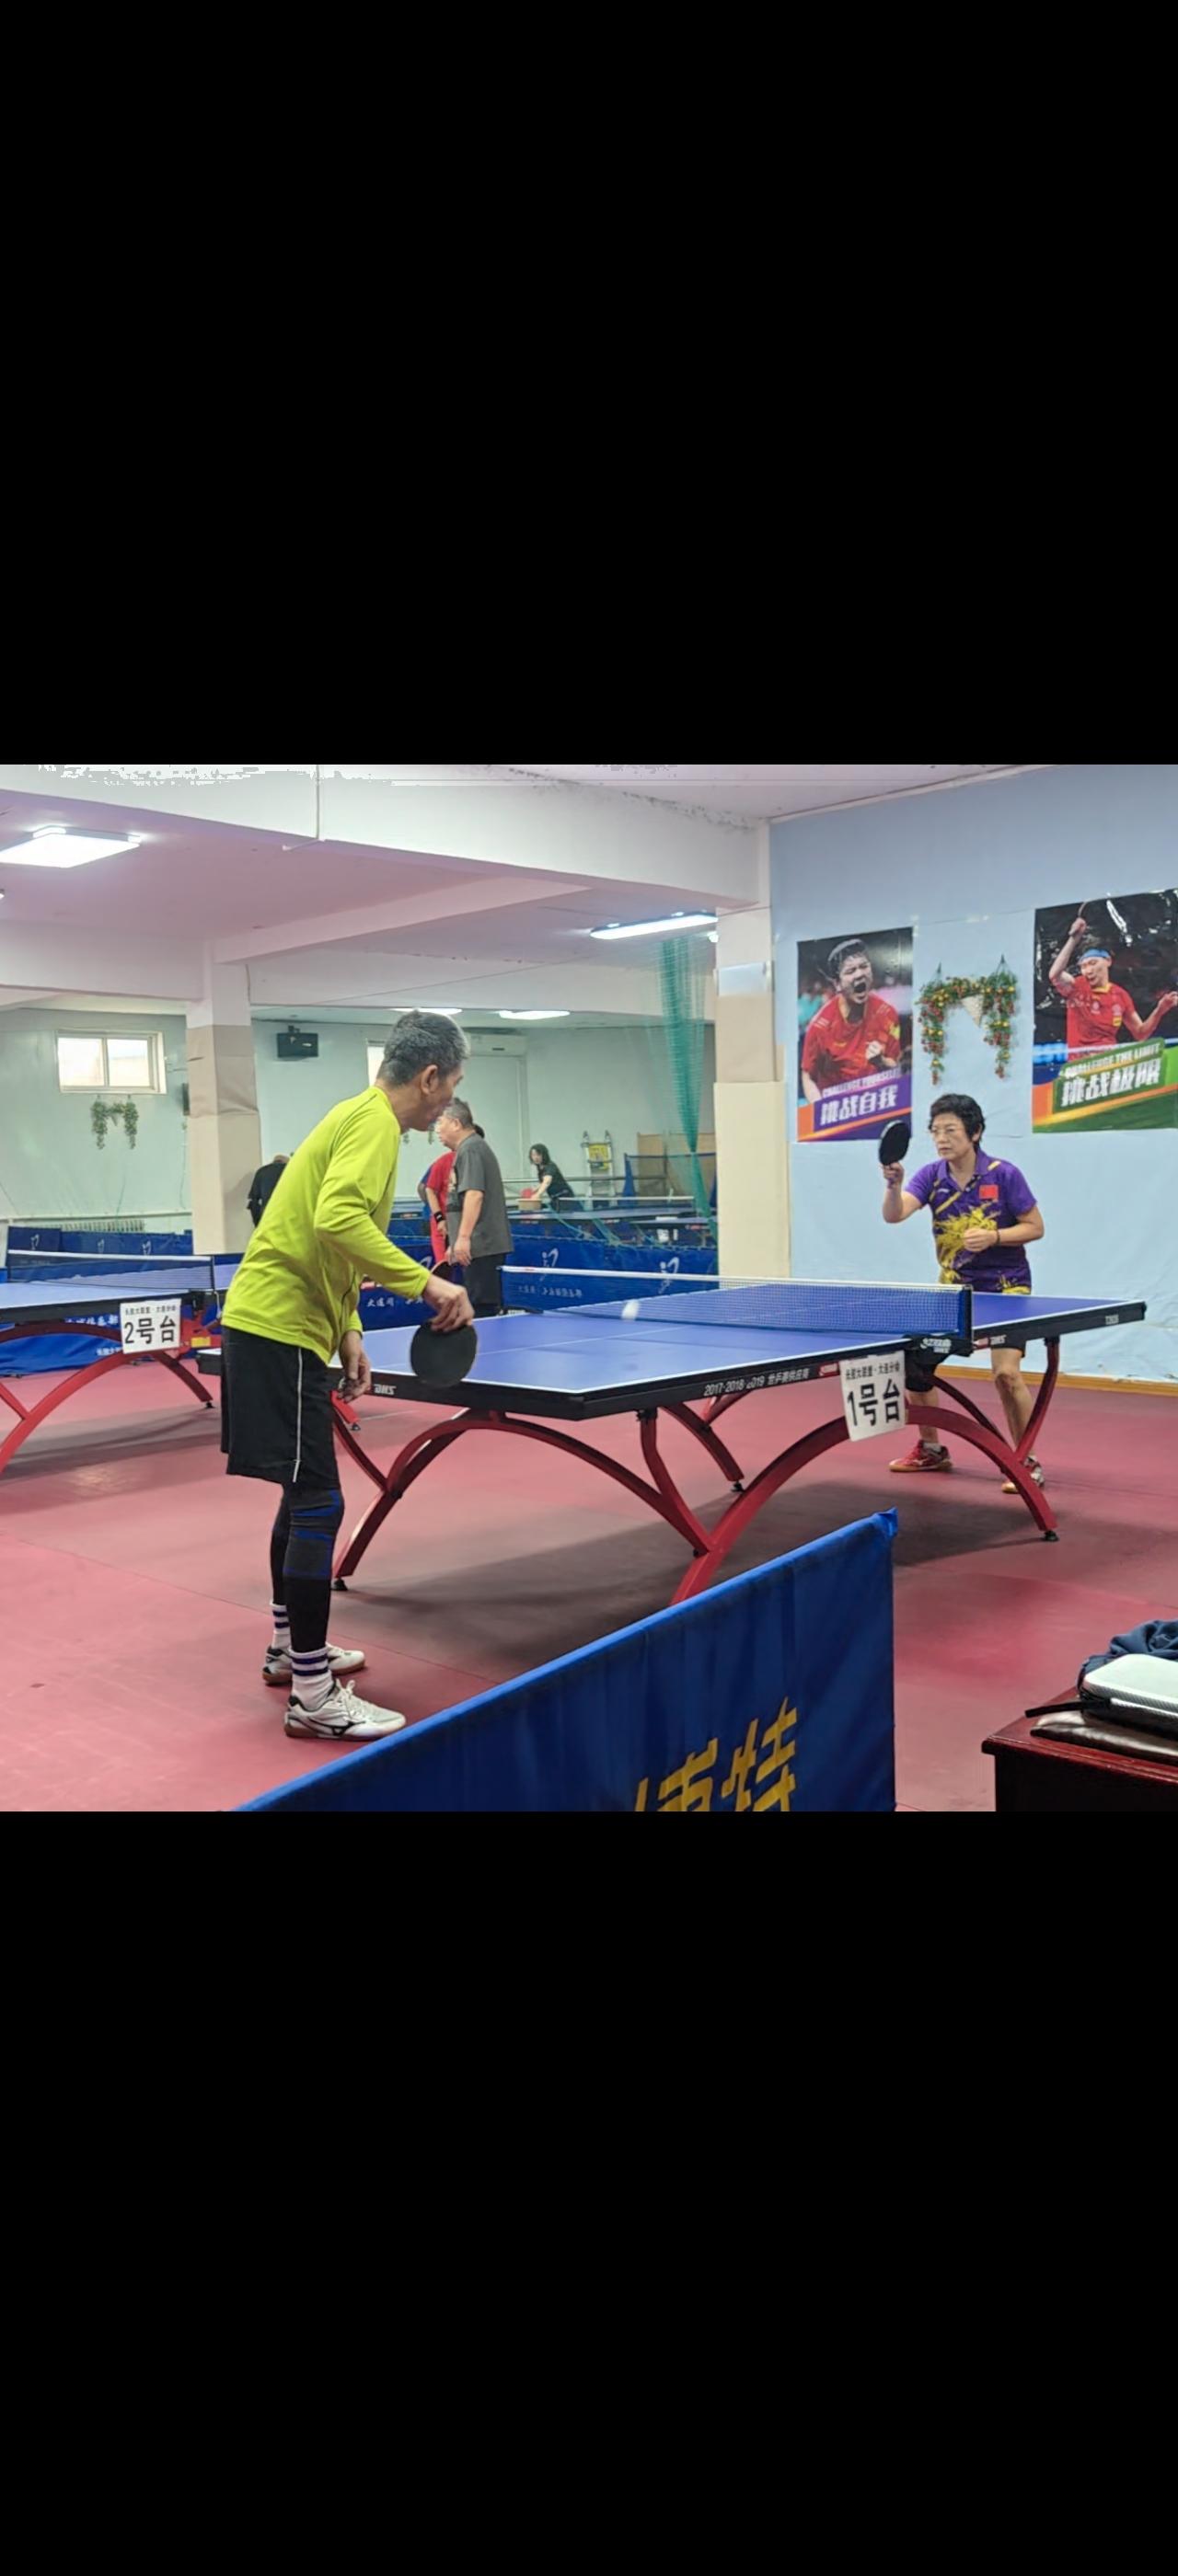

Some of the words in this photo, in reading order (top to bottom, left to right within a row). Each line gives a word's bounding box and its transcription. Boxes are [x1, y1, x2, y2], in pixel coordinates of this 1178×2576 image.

[1060, 1057, 1161, 1107] 挑战极限
[820, 1085, 898, 1125] 挑战自我
[124, 1316, 176, 1344] 2号台
[847, 1378, 900, 1427] 1号台
